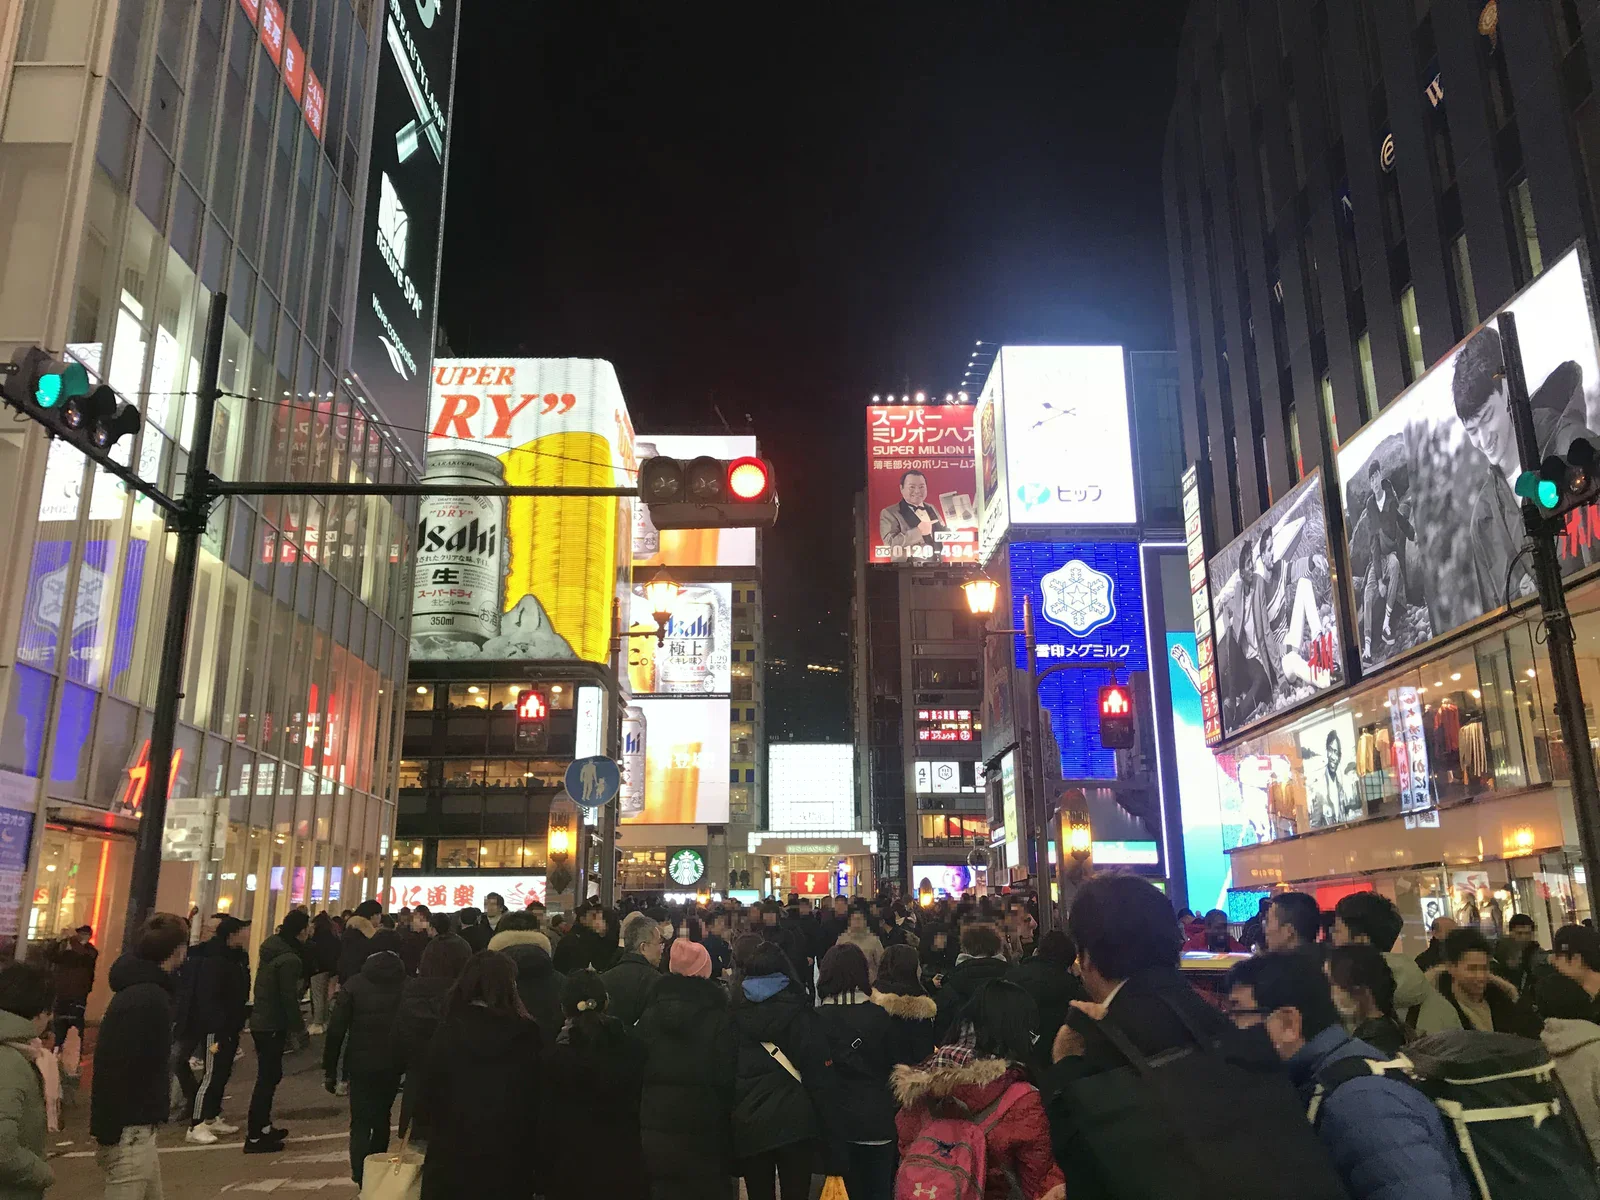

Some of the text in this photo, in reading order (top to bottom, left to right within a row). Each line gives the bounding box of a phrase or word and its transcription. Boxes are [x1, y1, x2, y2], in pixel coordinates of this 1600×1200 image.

[376, 229, 420, 319] nature SPA
[432, 366, 515, 386] UPER
[872, 409, 942, 426] スーパー
[872, 427, 975, 443] ミリオンヘア
[873, 445, 914, 455] SUPER
[918, 445, 965, 455] MILLION
[432, 568, 459, 585] 生
[417, 589, 473, 598] スーパードライ
[430, 616, 455, 626] 350ml
[669, 641, 703, 656] 極上
[1035, 644, 1130, 658] 雪印メグミルク
[1203, 637, 1219, 730] インターネット
[1201, 682, 1212, 734] コミック
